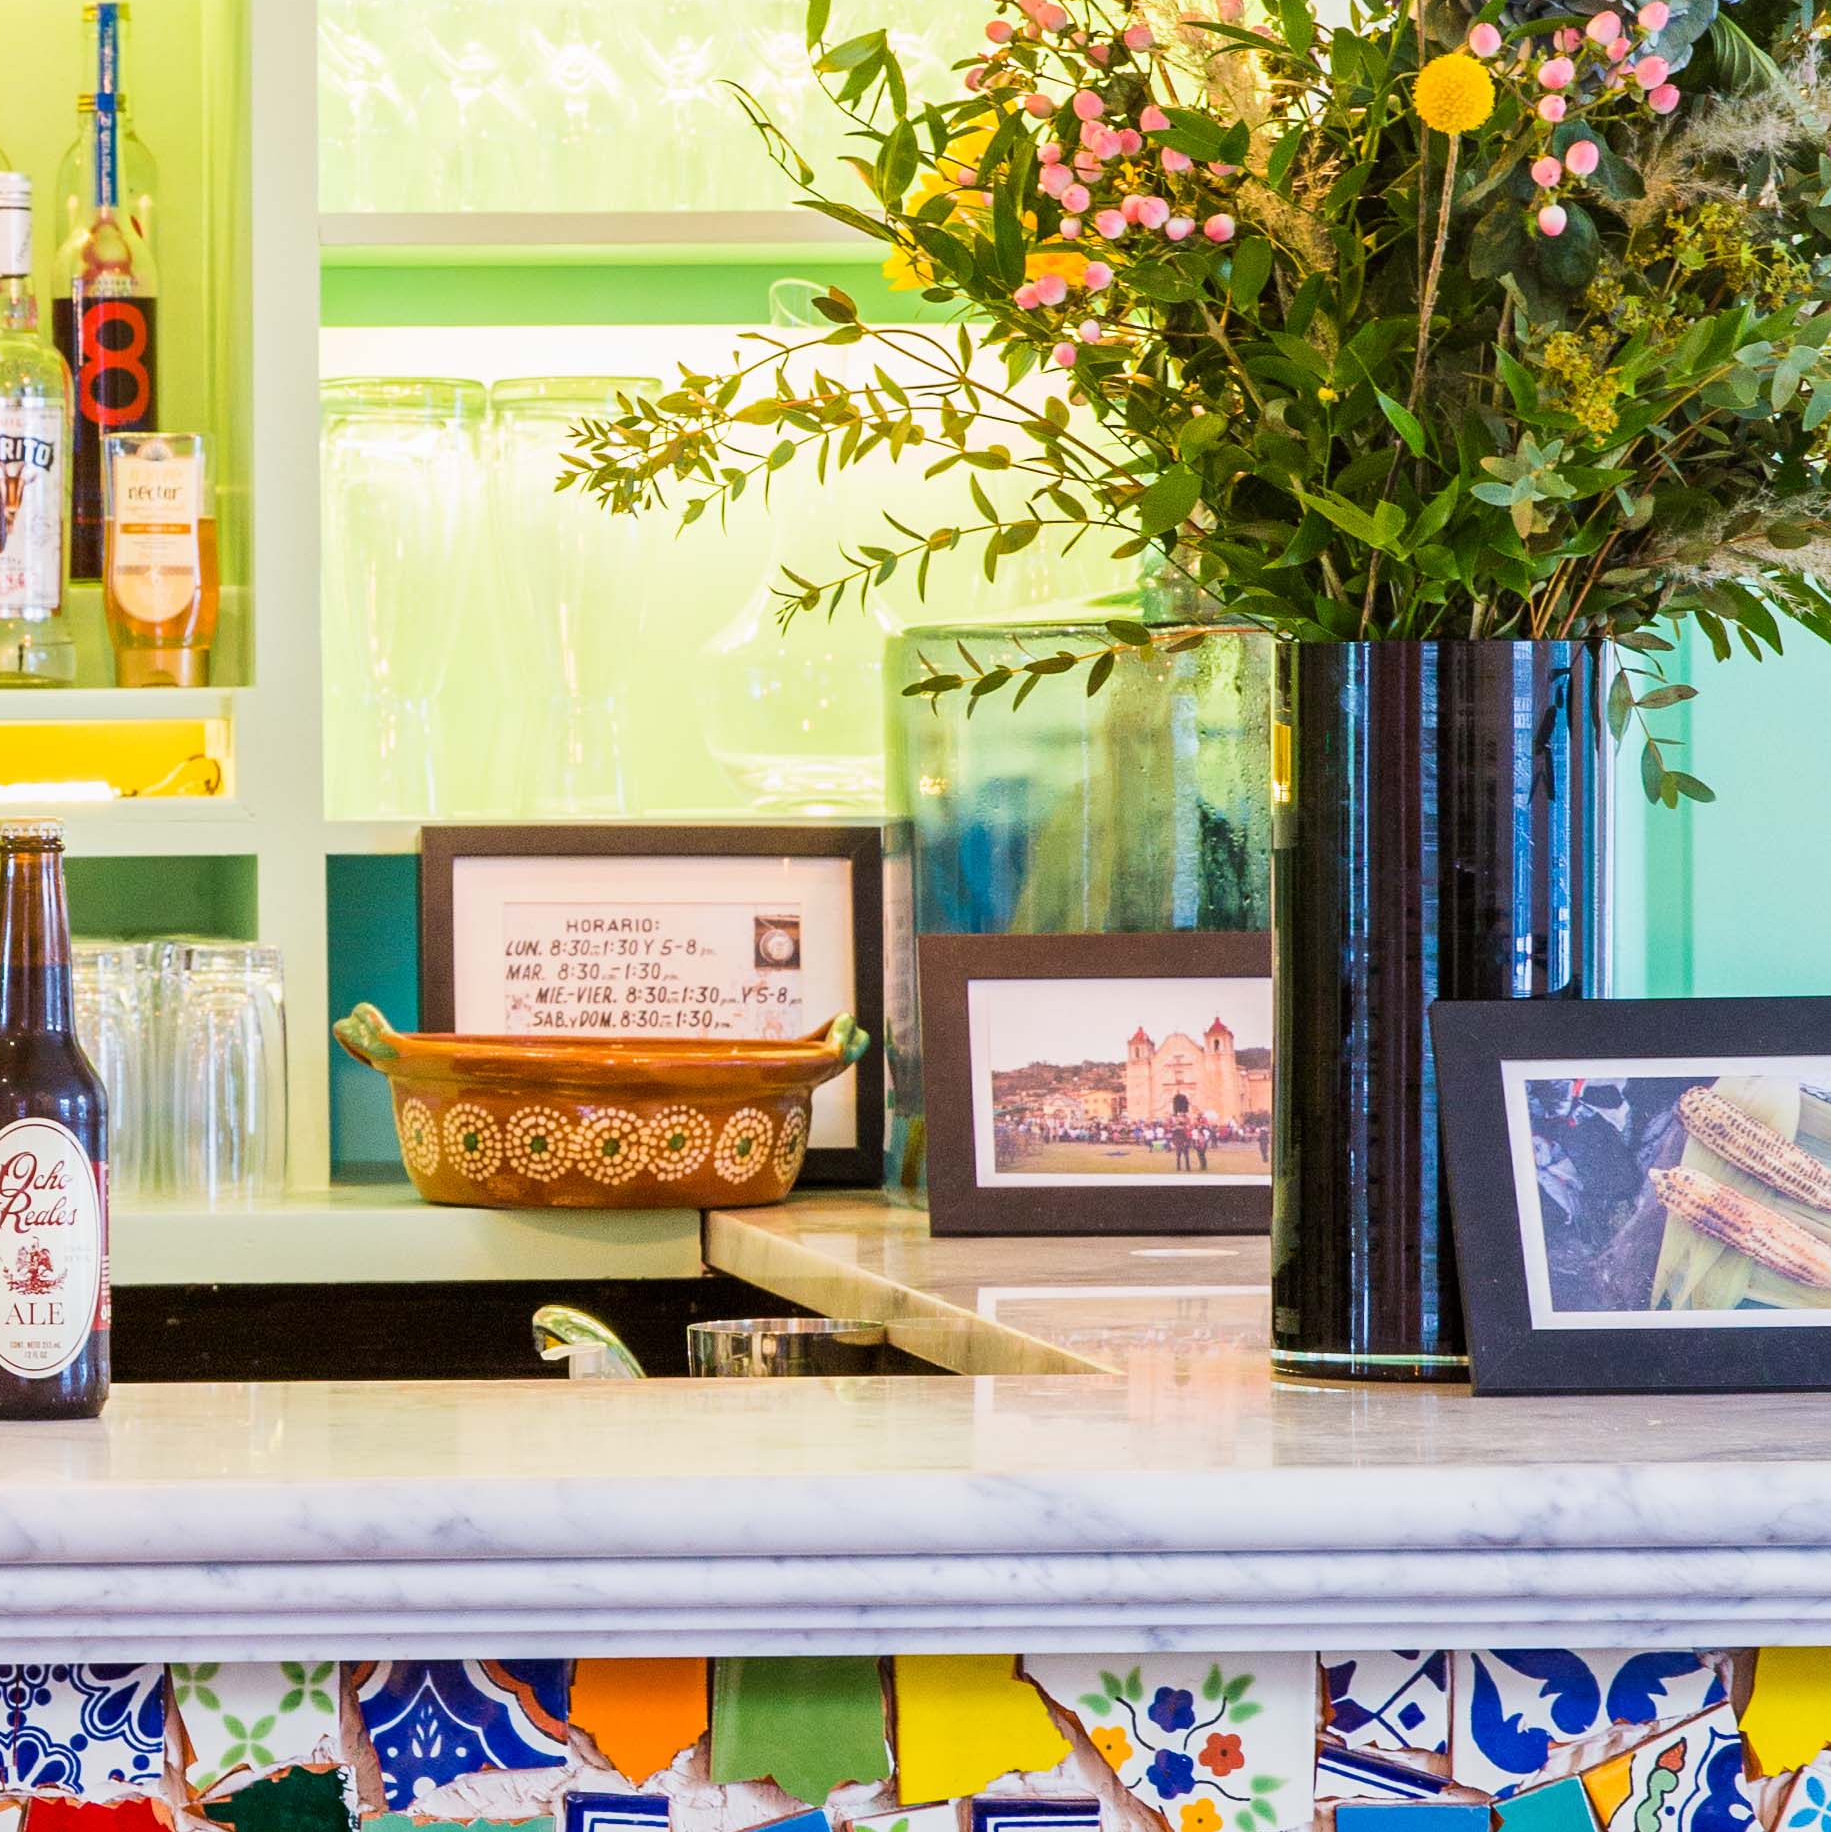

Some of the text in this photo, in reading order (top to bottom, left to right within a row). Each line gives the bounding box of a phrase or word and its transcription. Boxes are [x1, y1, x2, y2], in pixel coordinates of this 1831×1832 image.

[80, 302, 149, 426] 8
[566, 919, 660, 933] HORARIO:
[505, 939, 542, 956] LUN.
[506, 963, 546, 981] MAR.
[5, 1302, 65, 1326] ALE
